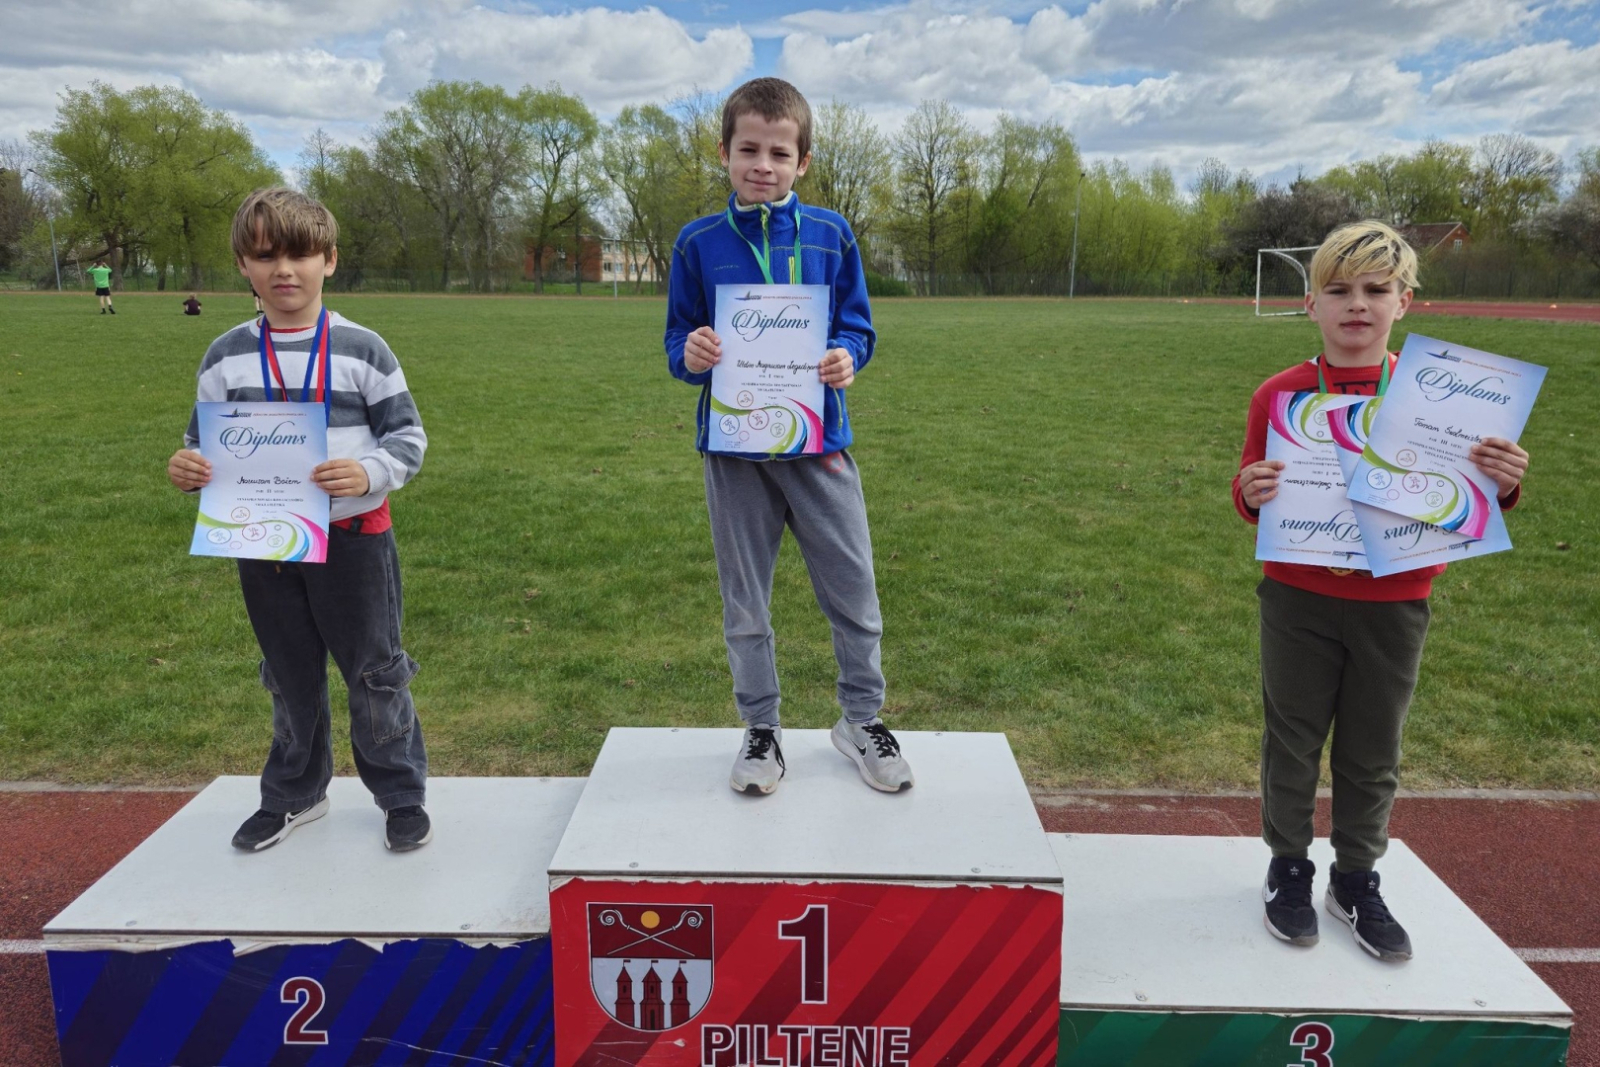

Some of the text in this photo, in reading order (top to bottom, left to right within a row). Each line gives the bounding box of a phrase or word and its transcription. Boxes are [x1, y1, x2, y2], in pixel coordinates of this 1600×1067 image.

[731, 304, 810, 342] Diploms
[1415, 366, 1511, 405] Diploms
[220, 421, 307, 459] Diploms
[1279, 509, 1363, 544] Diploms
[1384, 522, 1456, 551] iloms
[778, 904, 829, 1005] 1
[280, 976, 329, 1047] 2
[701, 1024, 911, 1067] PILTENE
[1287, 1022, 1335, 1067] 3
